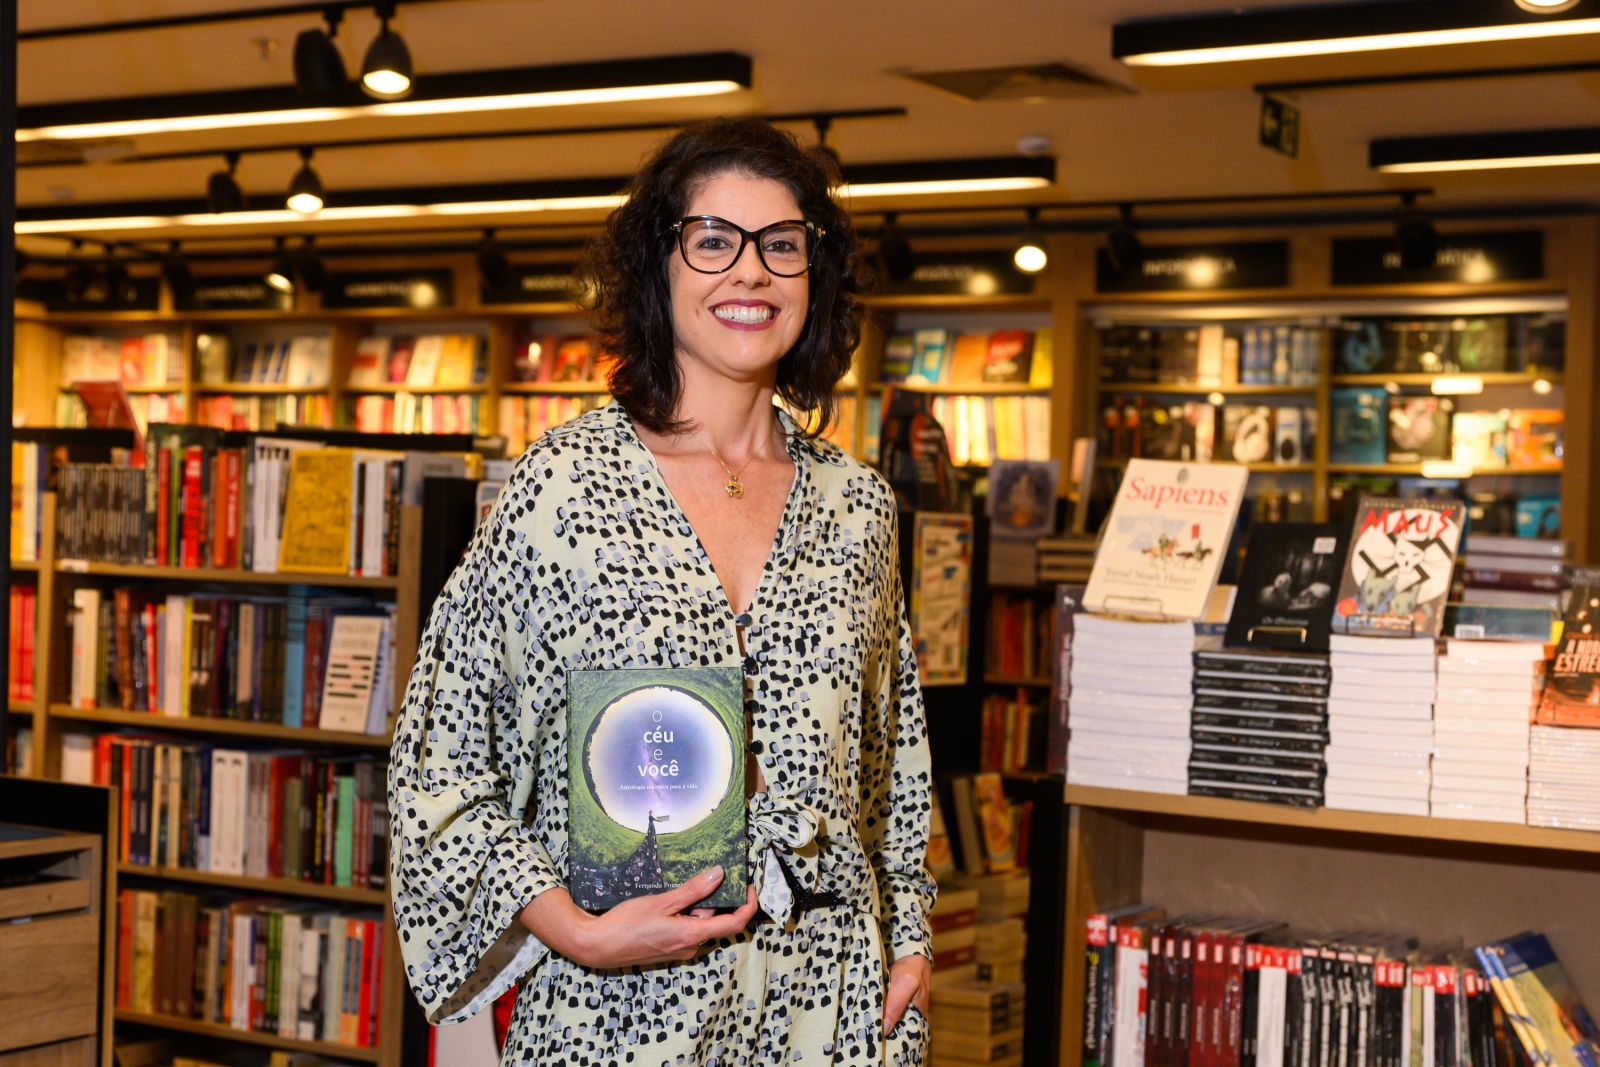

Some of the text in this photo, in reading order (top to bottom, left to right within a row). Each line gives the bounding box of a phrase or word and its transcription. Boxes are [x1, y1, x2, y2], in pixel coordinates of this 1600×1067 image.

[1126, 476, 1230, 509] Sapiens
[1360, 508, 1454, 538] MAUS
[652, 710, 663, 722] O
[643, 725, 674, 743] céu
[653, 748, 663, 761] e
[637, 759, 679, 777] você
[635, 882, 663, 890] Fernanda
